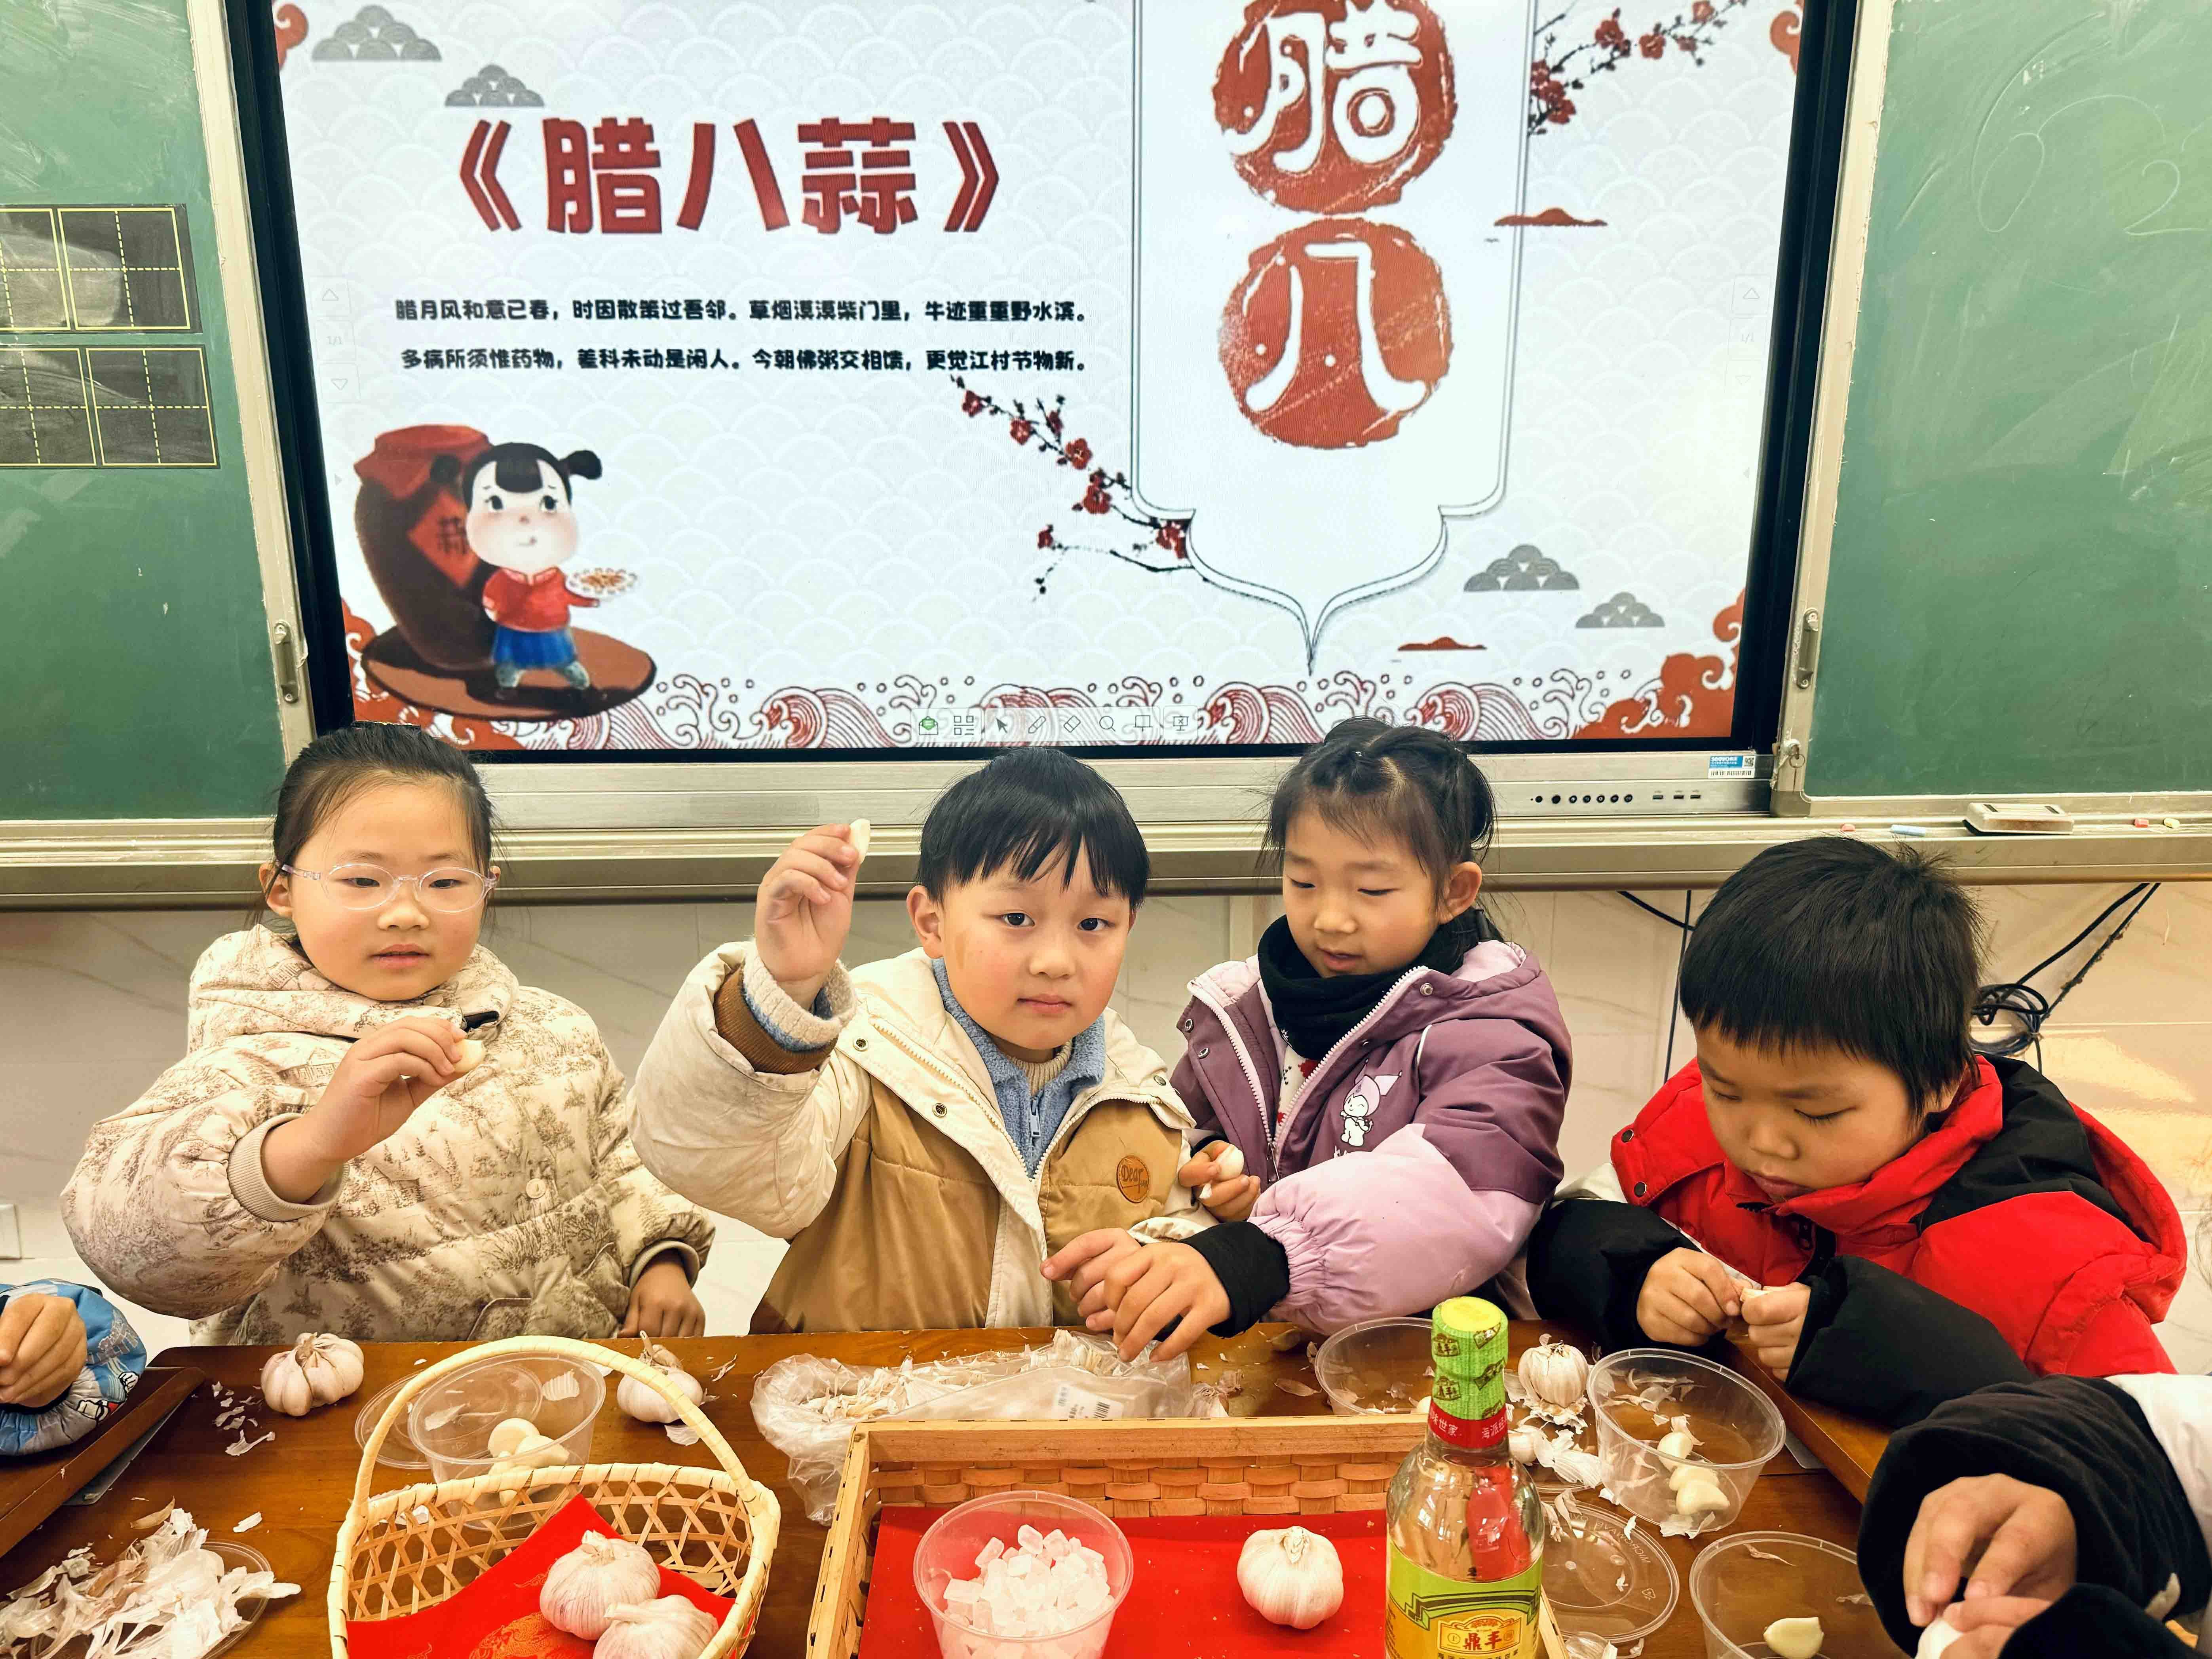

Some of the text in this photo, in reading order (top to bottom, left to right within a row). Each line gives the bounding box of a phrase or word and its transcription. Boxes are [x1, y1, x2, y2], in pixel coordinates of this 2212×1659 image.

[460, 117, 999, 234] 《腊八蒜》
[1463, 1630, 1502, 1651] 鼎丰
